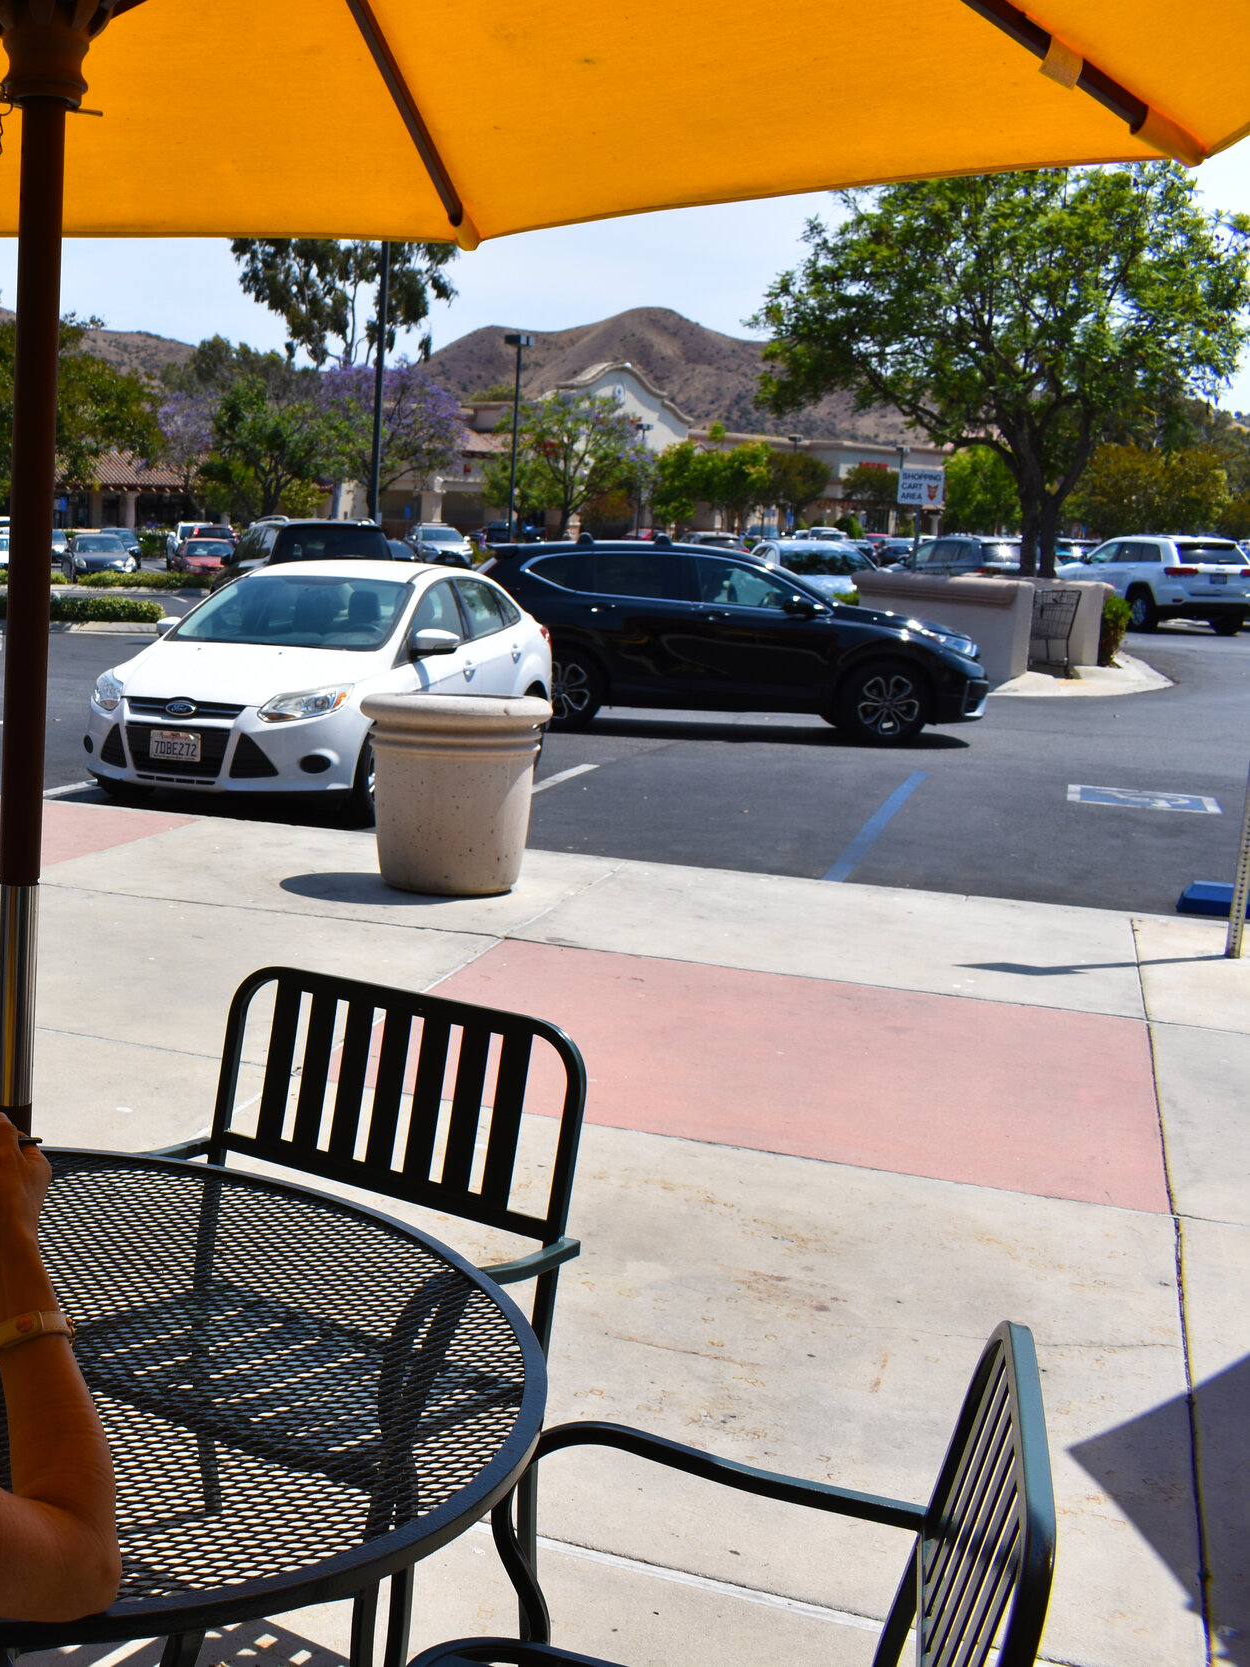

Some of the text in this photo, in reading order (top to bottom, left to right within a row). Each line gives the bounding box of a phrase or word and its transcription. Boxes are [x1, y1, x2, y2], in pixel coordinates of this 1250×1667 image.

[901, 472, 942, 482] SHOPPING
[901, 482, 923, 490] CART
[900, 492, 923, 500] AREA
[153, 740, 197, 757] 7DBE272
